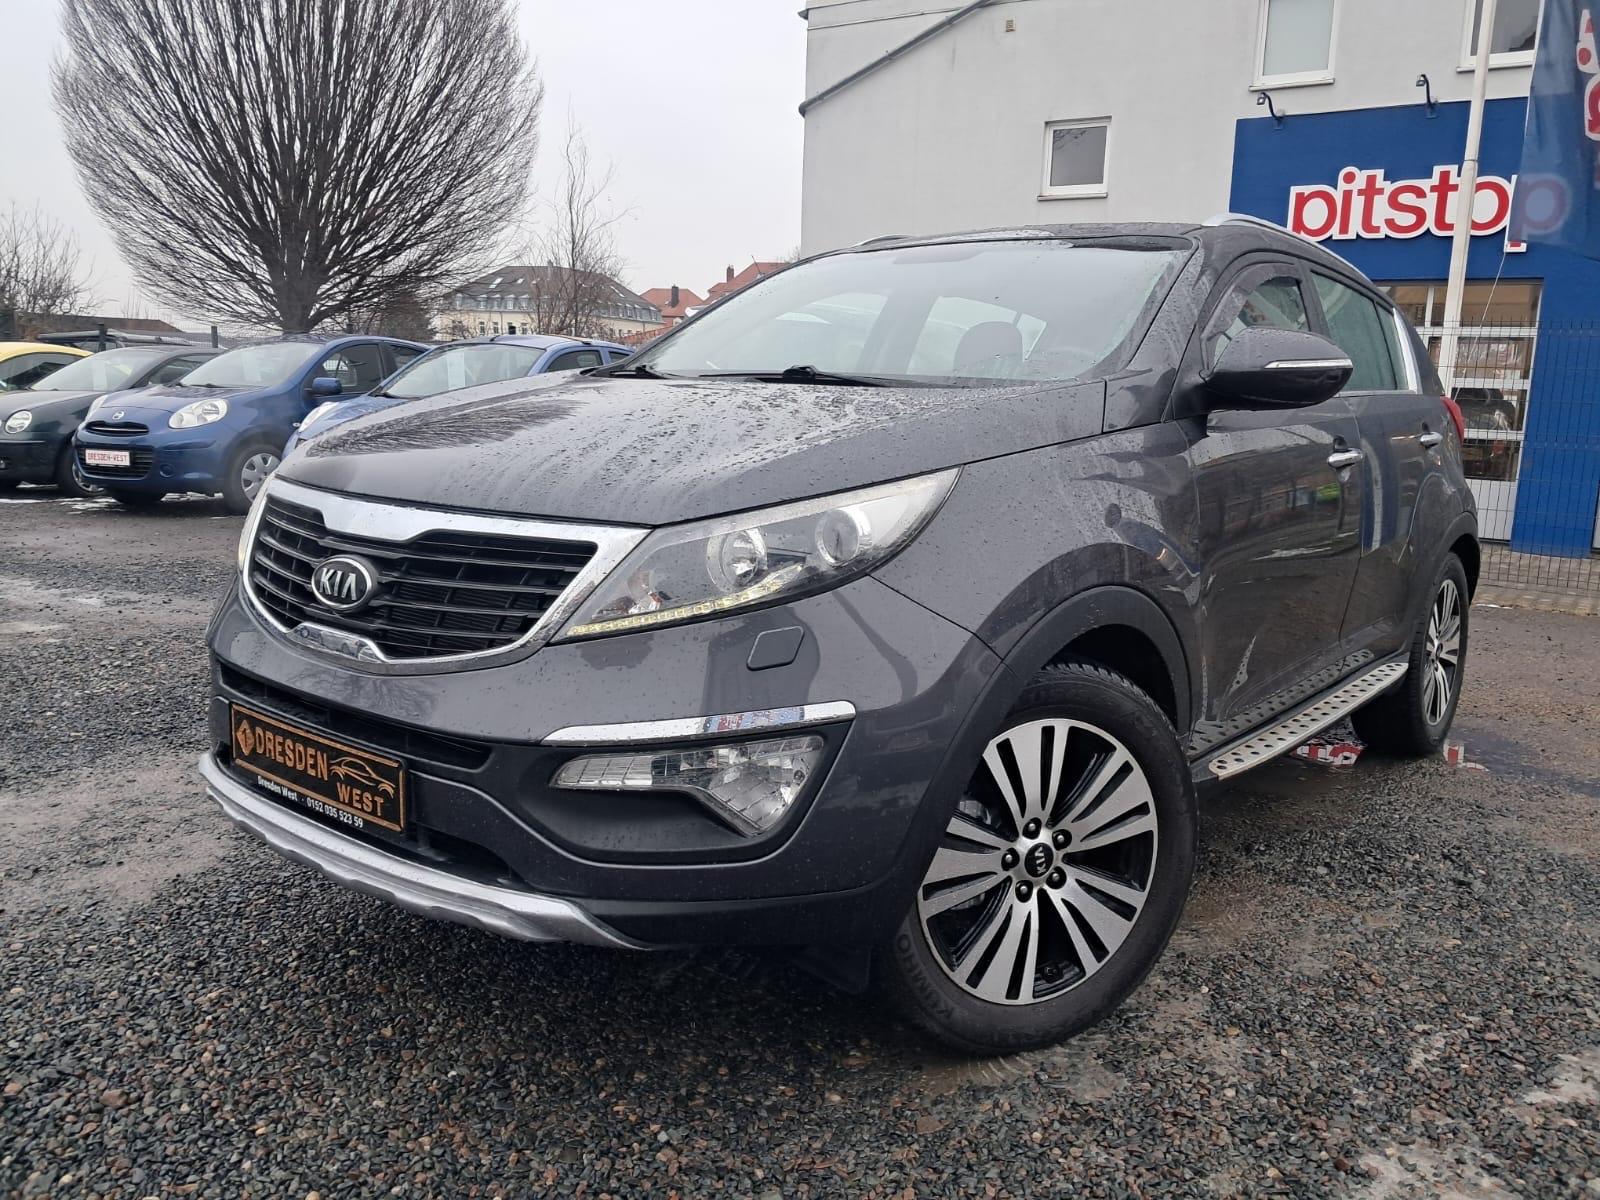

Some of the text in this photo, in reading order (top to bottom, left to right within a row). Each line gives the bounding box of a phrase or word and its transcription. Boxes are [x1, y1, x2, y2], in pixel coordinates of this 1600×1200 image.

[1290, 167, 1568, 250] pitstop
[319, 567, 357, 601] KIA
[255, 726, 328, 781] DRESDEN
[257, 775, 364, 829] Dresden West 0152 035 523 59
[336, 782, 384, 816] WEST
[1035, 846, 1047, 874] KIA
